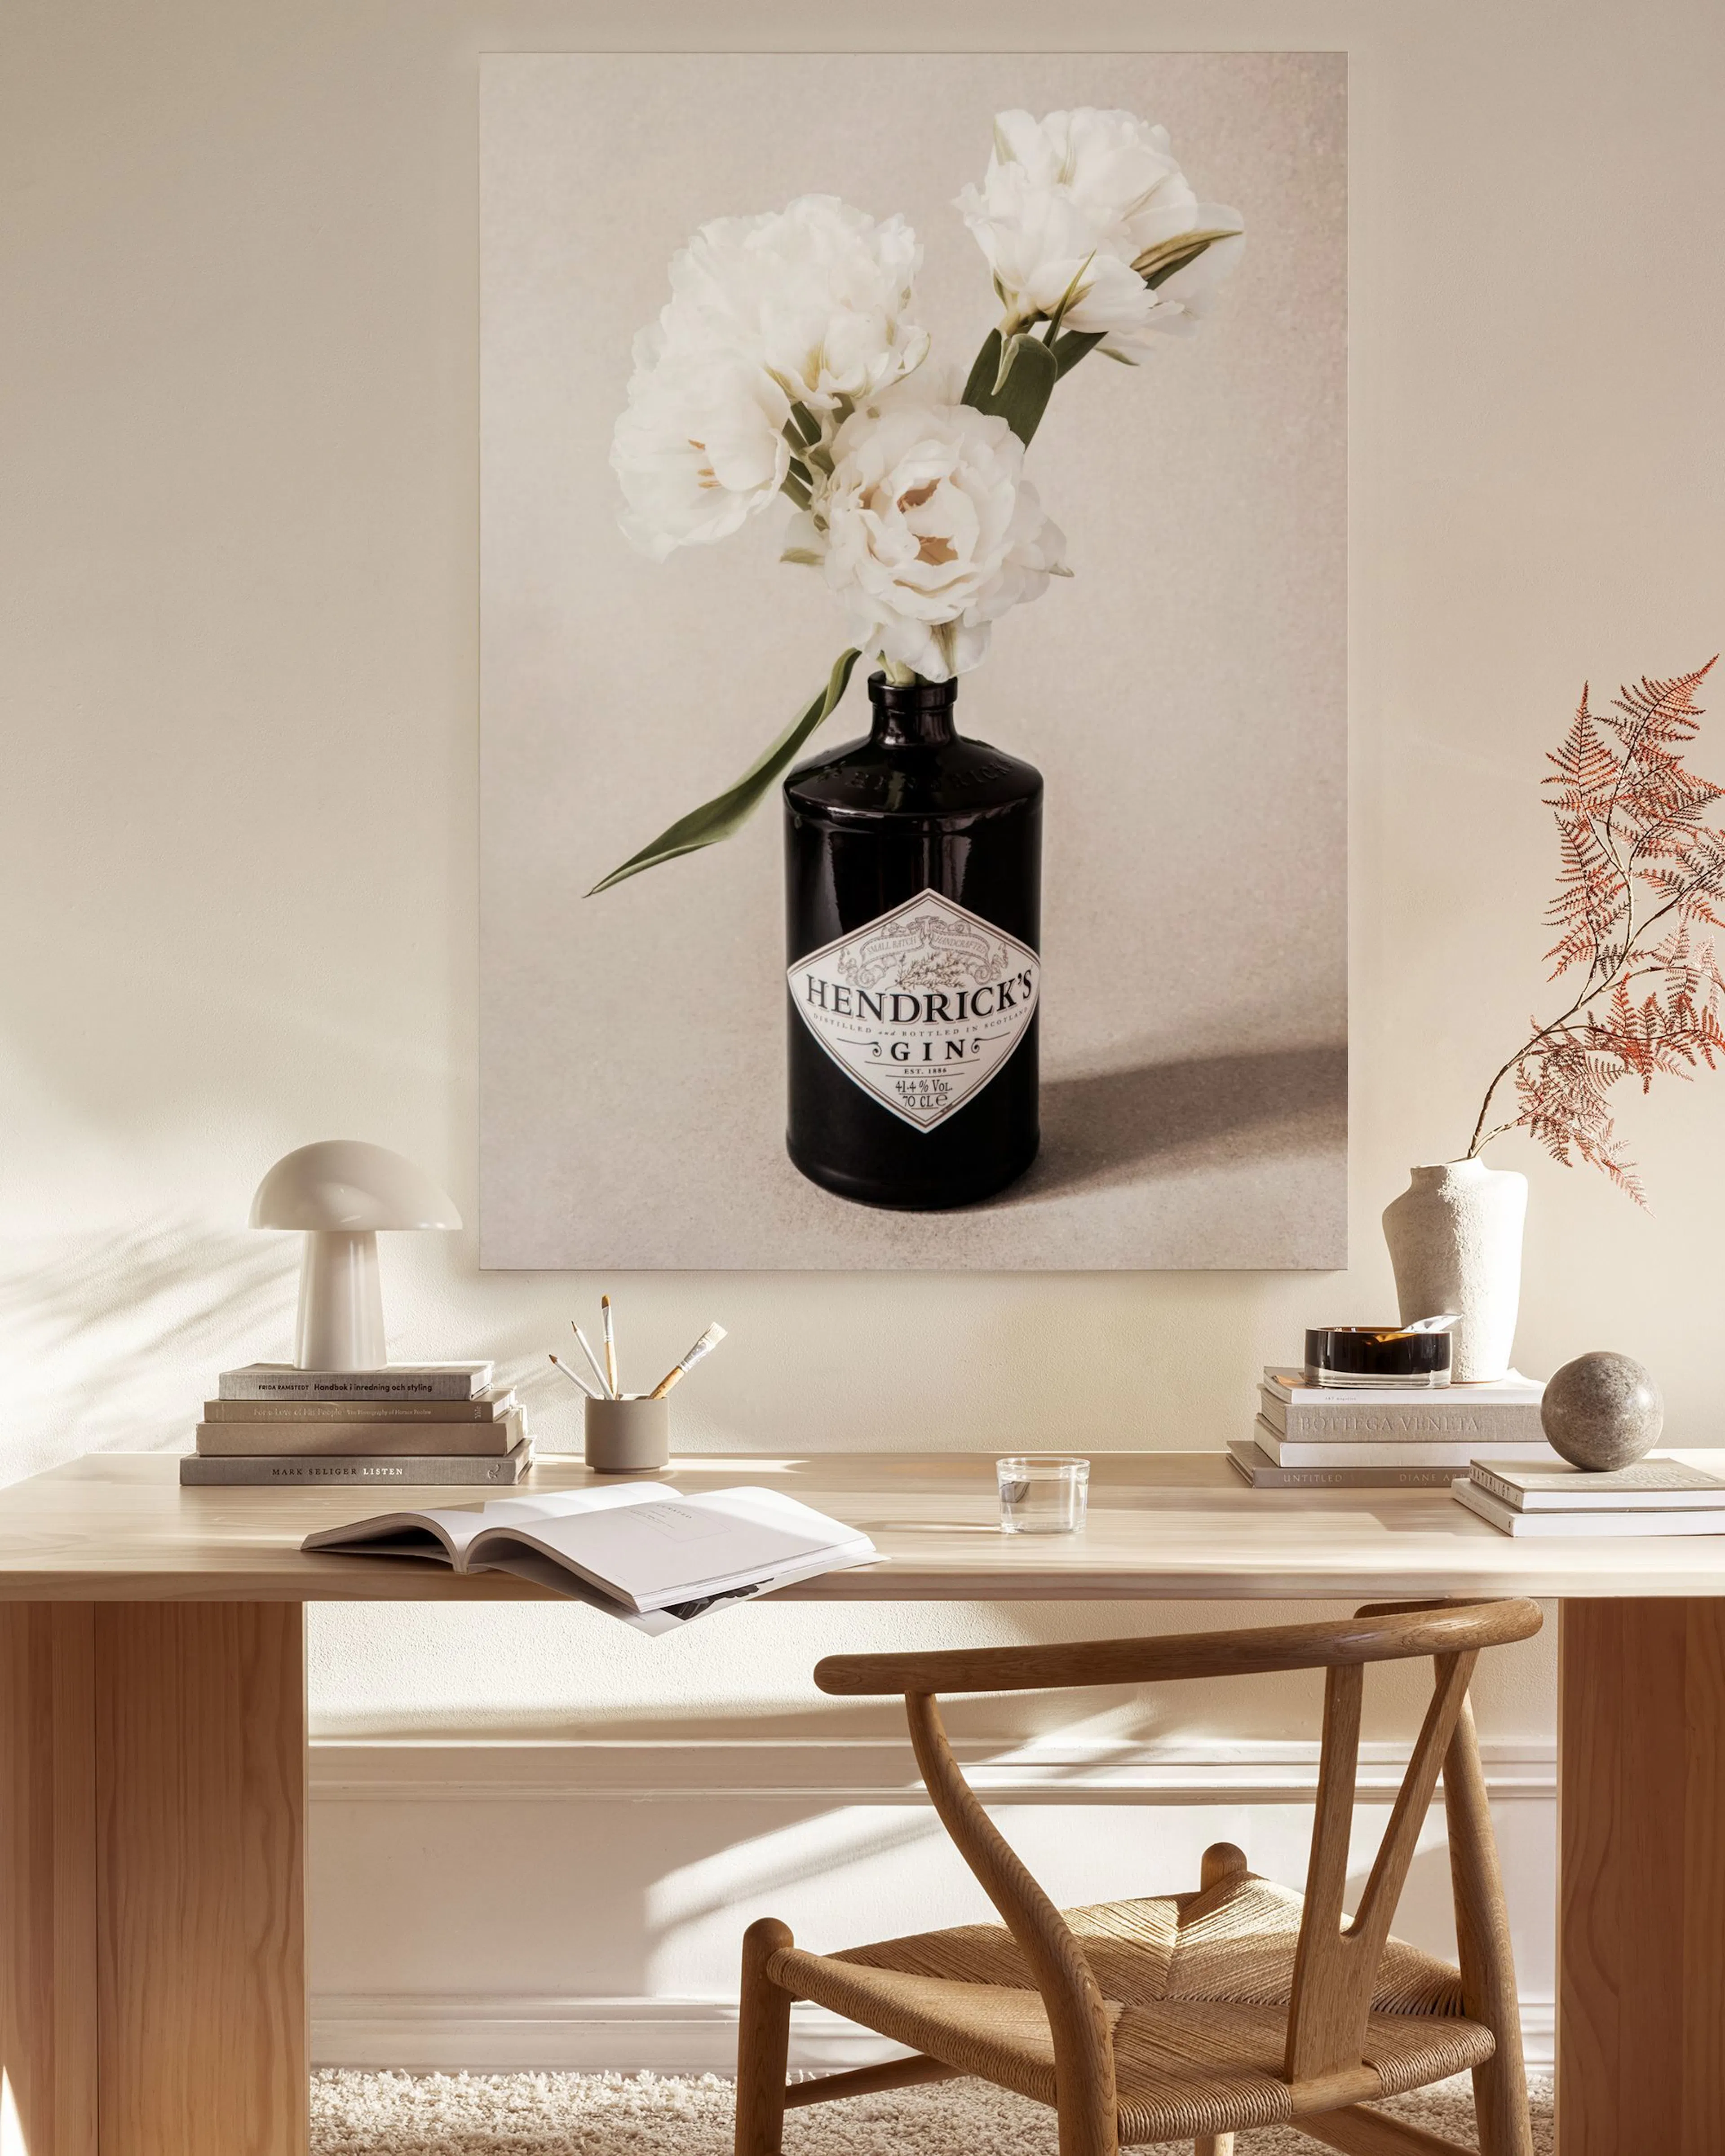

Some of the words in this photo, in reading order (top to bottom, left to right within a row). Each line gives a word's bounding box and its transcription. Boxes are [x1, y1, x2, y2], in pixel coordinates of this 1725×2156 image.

[806, 970, 1032, 1025] HENDRICK'S
[814, 1013, 871, 1033] DISTILLED
[902, 1029, 959, 1037] BOTTLED
[984, 1007, 1028, 1029] SCOTLAND
[891, 1039, 965, 1061] GIN
[902, 1096, 916, 1107] 70
[354, 1383, 390, 1392] inredning
[407, 1383, 433, 1392] styling
[1300, 1417, 1393, 1431] BOTTEGA
[1400, 1416, 1479, 1431] VENETA
[363, 1467, 403, 1476] LISTEN
[1283, 1474, 1343, 1482] UNTITLED
[1399, 1474, 1437, 1482] DIANE
